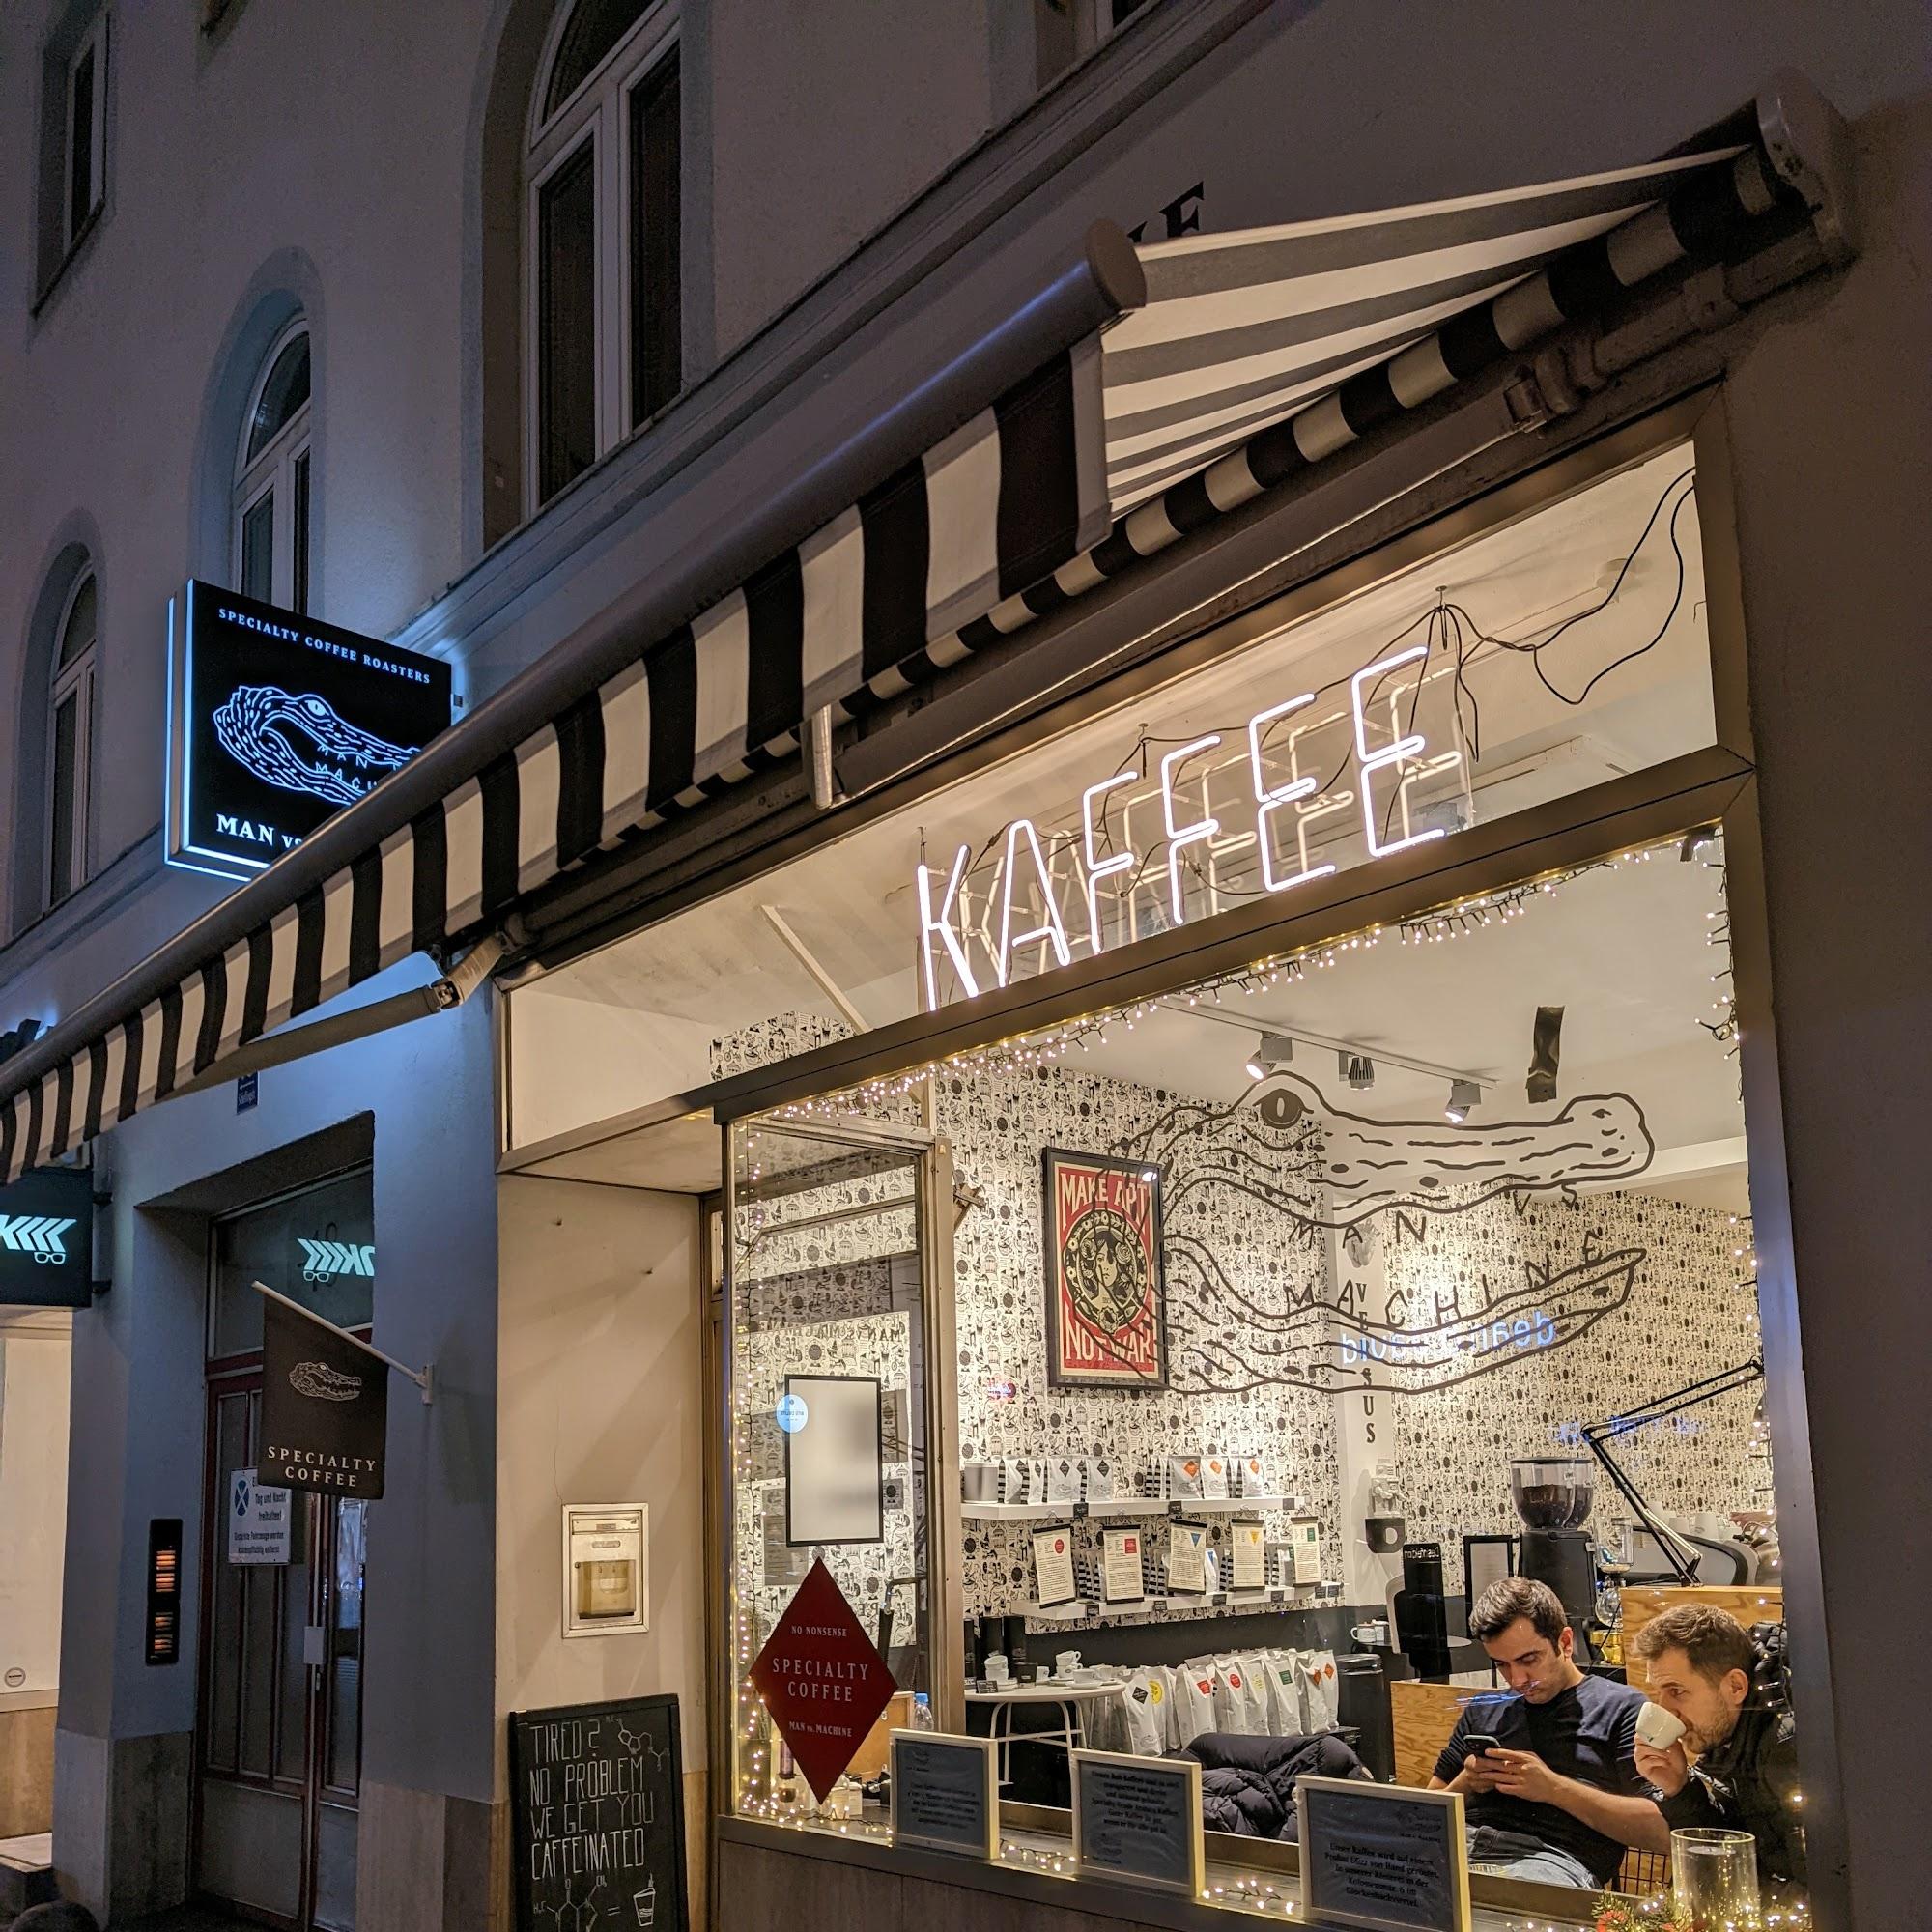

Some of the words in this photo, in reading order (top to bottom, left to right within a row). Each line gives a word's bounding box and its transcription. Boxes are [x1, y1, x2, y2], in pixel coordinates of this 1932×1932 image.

[218, 608, 299, 642] SPECIALTY
[305, 636, 357, 662] COFFEE
[363, 654, 431, 685] ROASTERS
[317, 744, 368, 769] MAN
[216, 813, 274, 846] MAN
[918, 646, 1446, 1011] KAFFEE
[1061, 1172, 1109, 1232] MAKE
[1114, 1179, 1153, 1235] ART
[1288, 1210, 1427, 1250] MAN
[1514, 1184, 1578, 1217] VS
[1285, 1231, 1604, 1327] MACHINE
[1065, 1307, 1109, 1362] NOT
[1110, 1315, 1154, 1364] WAR
[268, 1444, 377, 1473] SPECIALTY
[285, 1464, 358, 1489] COFFEE
[791, 1625, 803, 1636] NO
[806, 1626, 847, 1637] NONSENSE
[773, 1657, 869, 1681] SPECIALTY
[787, 1681, 853, 1703] COFFEE
[788, 1720, 806, 1734] MAN
[815, 1723, 853, 1738] MACHINE
[529, 1769, 552, 1807] NO
[564, 1756, 644, 1803] PROBLEM
[530, 1806, 557, 1839] WE
[563, 1798, 606, 1833] GET
[616, 1791, 655, 1827] YOU
[531, 1828, 645, 1881] CAFFEINATED
